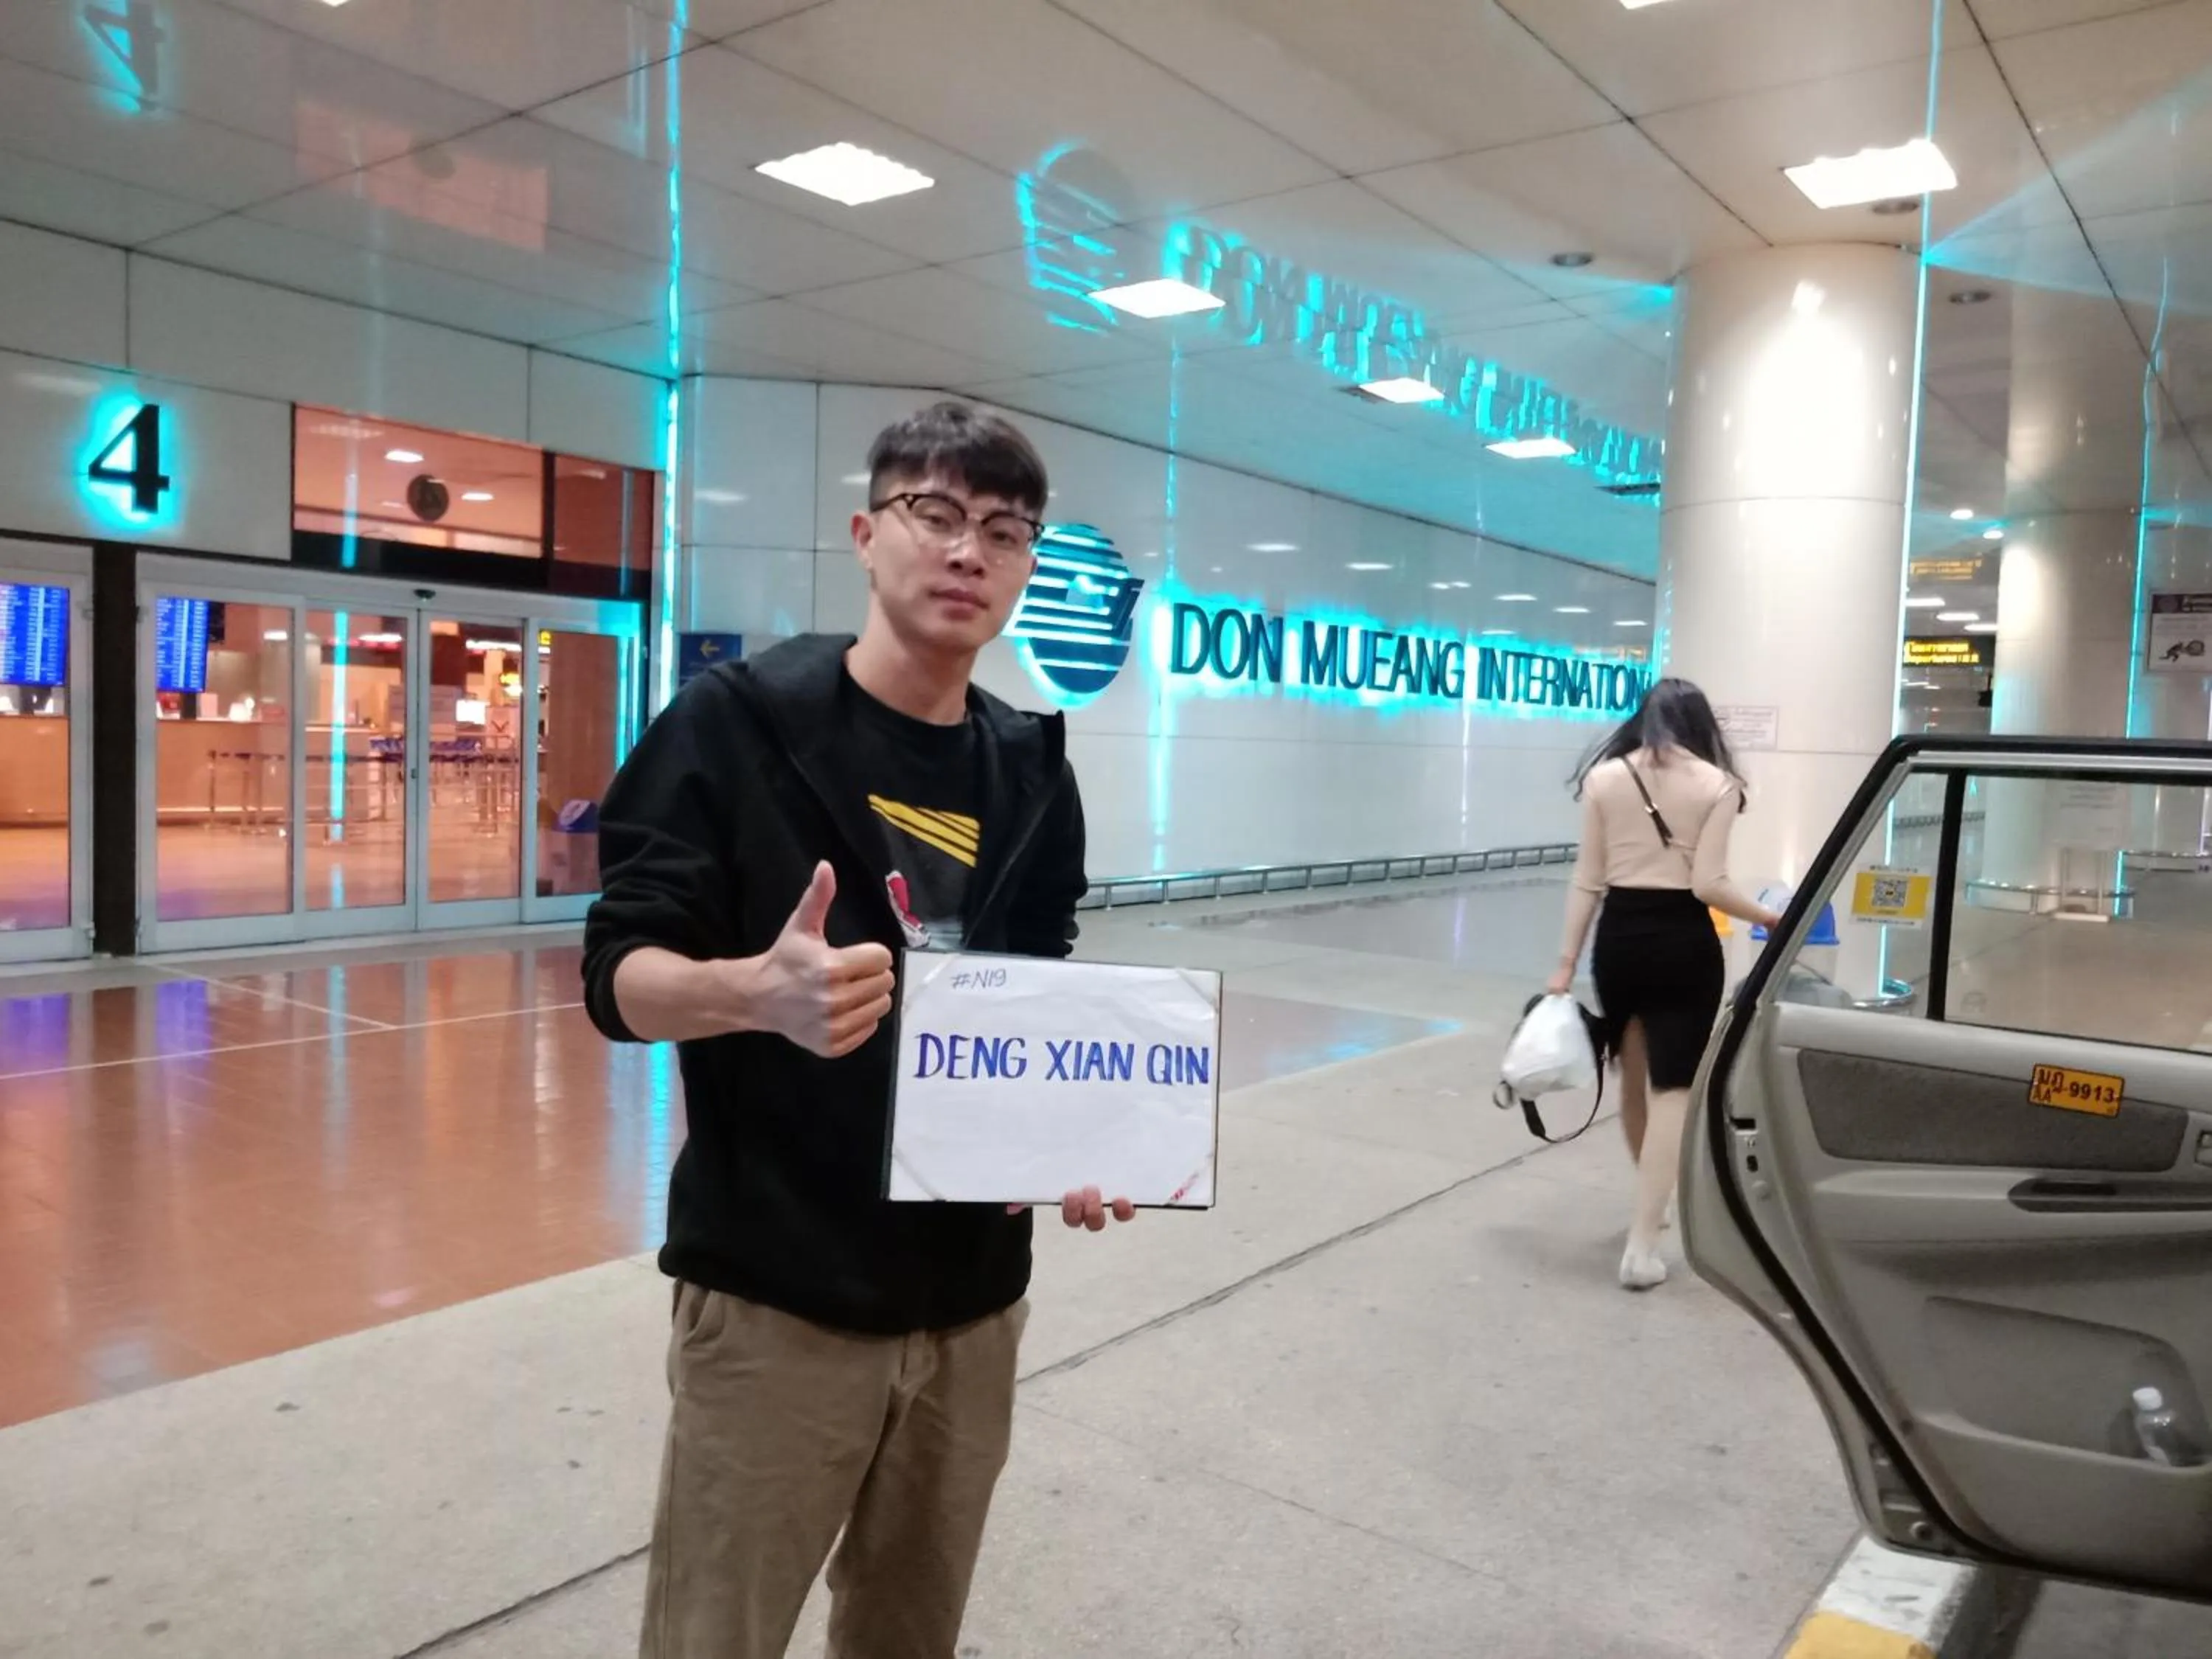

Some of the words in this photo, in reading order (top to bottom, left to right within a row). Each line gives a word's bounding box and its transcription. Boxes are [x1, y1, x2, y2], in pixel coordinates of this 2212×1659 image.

[88, 403, 170, 514] 4
[1170, 602, 1284, 683] DON
[1301, 620, 1464, 698] MUEANG
[1477, 647, 1652, 712] INTERNATION
[914, 1032, 1028, 1079] DENG
[1044, 1039, 1135, 1082] XIAN
[1147, 1043, 1210, 1086] QIN
